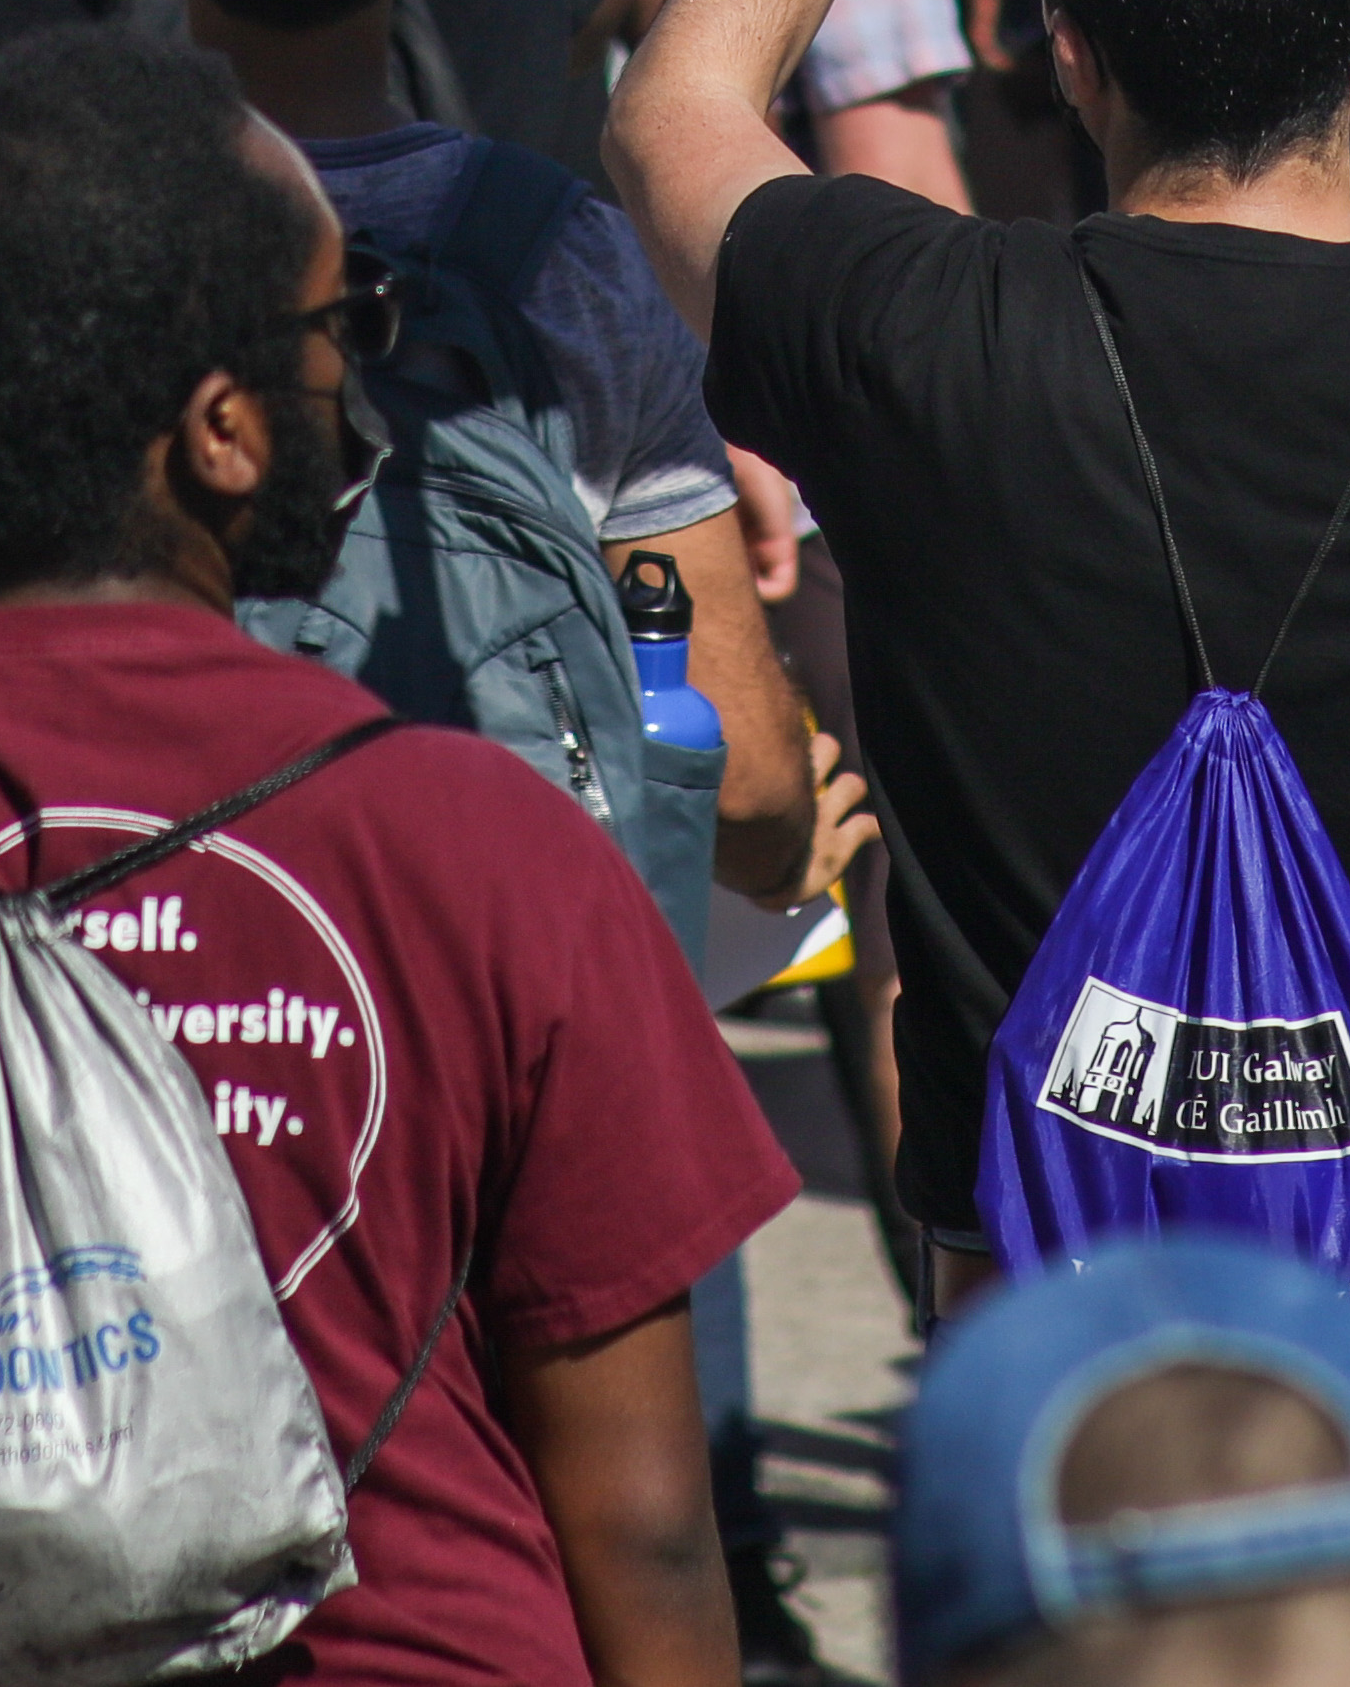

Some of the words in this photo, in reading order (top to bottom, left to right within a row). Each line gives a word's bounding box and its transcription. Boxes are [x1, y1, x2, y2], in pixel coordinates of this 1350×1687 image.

[136, 988, 355, 1059] versity.
[1243, 1050, 1336, 1089] Galway
[1219, 1097, 1346, 1135] Gaillimh
